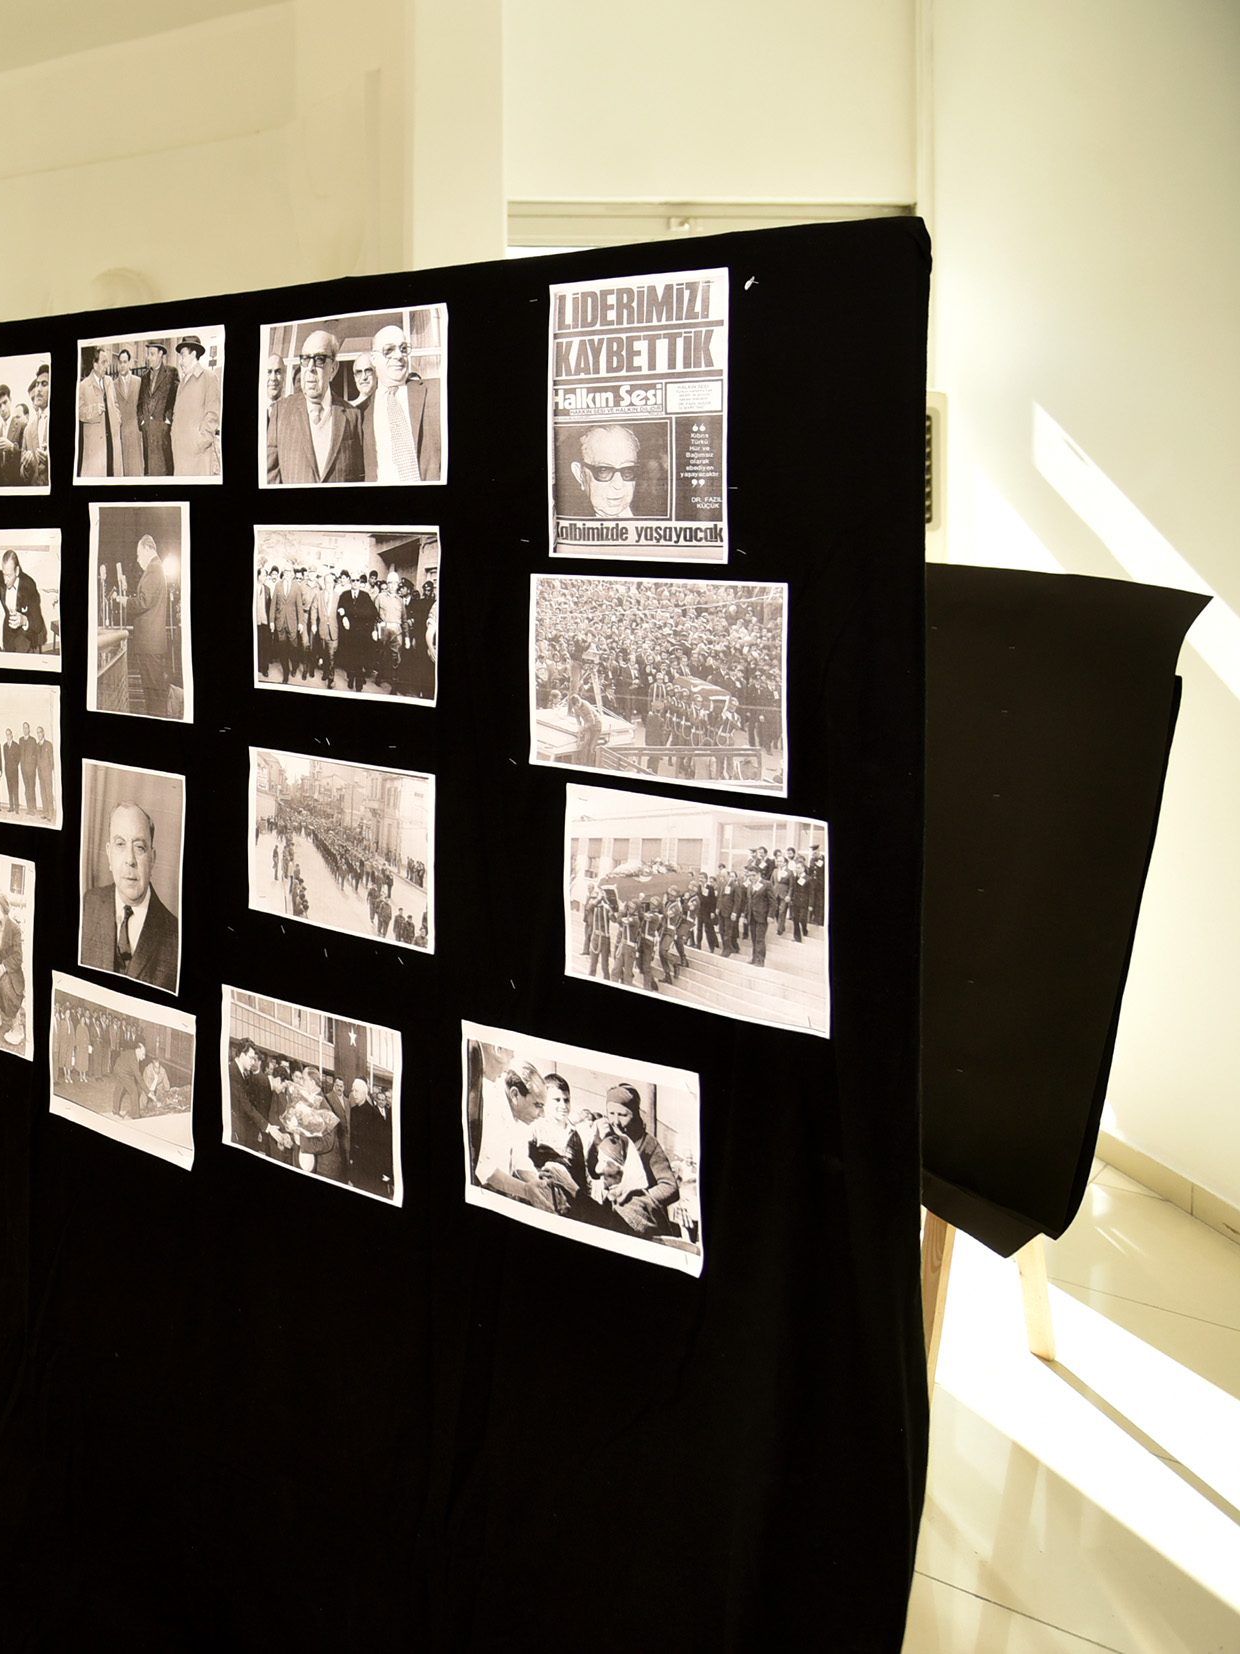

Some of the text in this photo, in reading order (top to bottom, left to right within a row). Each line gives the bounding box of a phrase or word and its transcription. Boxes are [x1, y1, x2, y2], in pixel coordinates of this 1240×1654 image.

[557, 281, 711, 332] LİDERİMİZİ
[555, 329, 715, 377] KAYBETTİK
[619, 384, 663, 407] Sesi
[635, 523, 724, 544] yaşayacak
